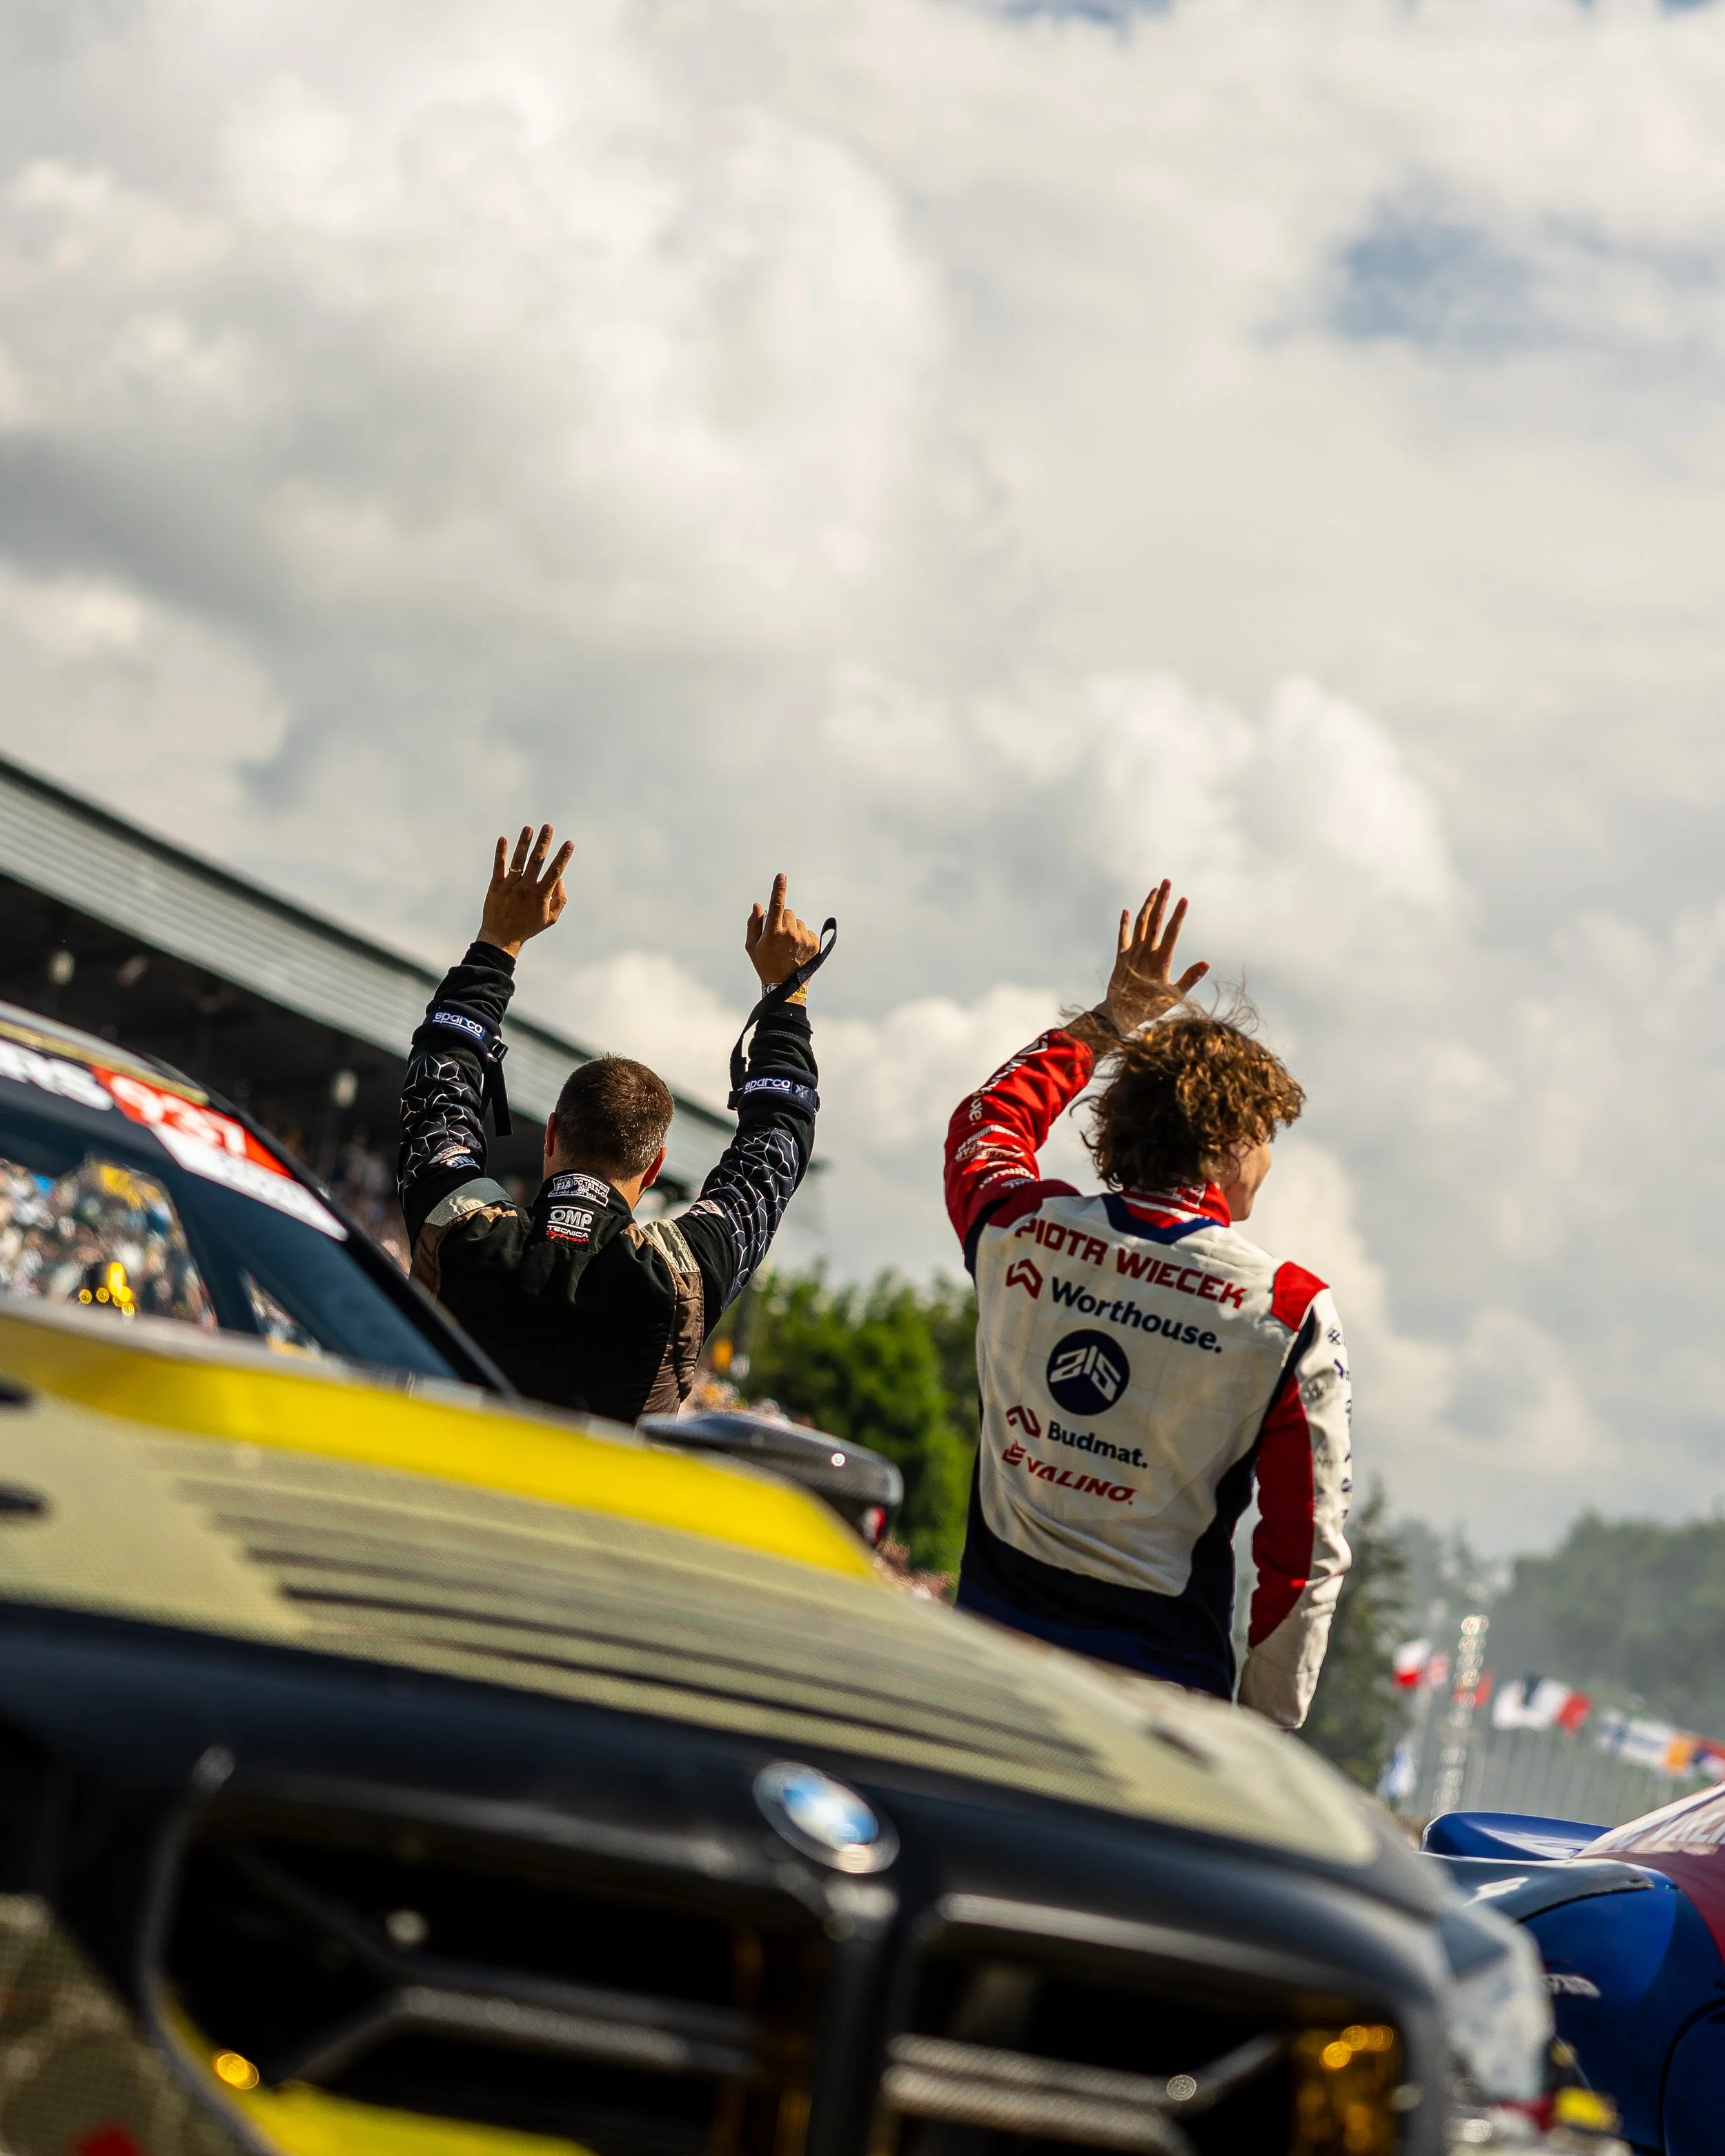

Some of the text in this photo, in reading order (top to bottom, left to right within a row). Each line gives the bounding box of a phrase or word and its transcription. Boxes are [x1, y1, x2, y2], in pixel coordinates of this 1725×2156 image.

[434, 1011, 484, 1034] sparco
[745, 1078, 791, 1093] sparco
[550, 1209, 593, 1227] OMP
[546, 1225, 589, 1238] TECNICA
[1014, 1218, 1249, 1309] PIOTR WIECEK
[1051, 1276, 1223, 1354] Worthouse.
[1047, 1419, 1148, 1469] Budmat.
